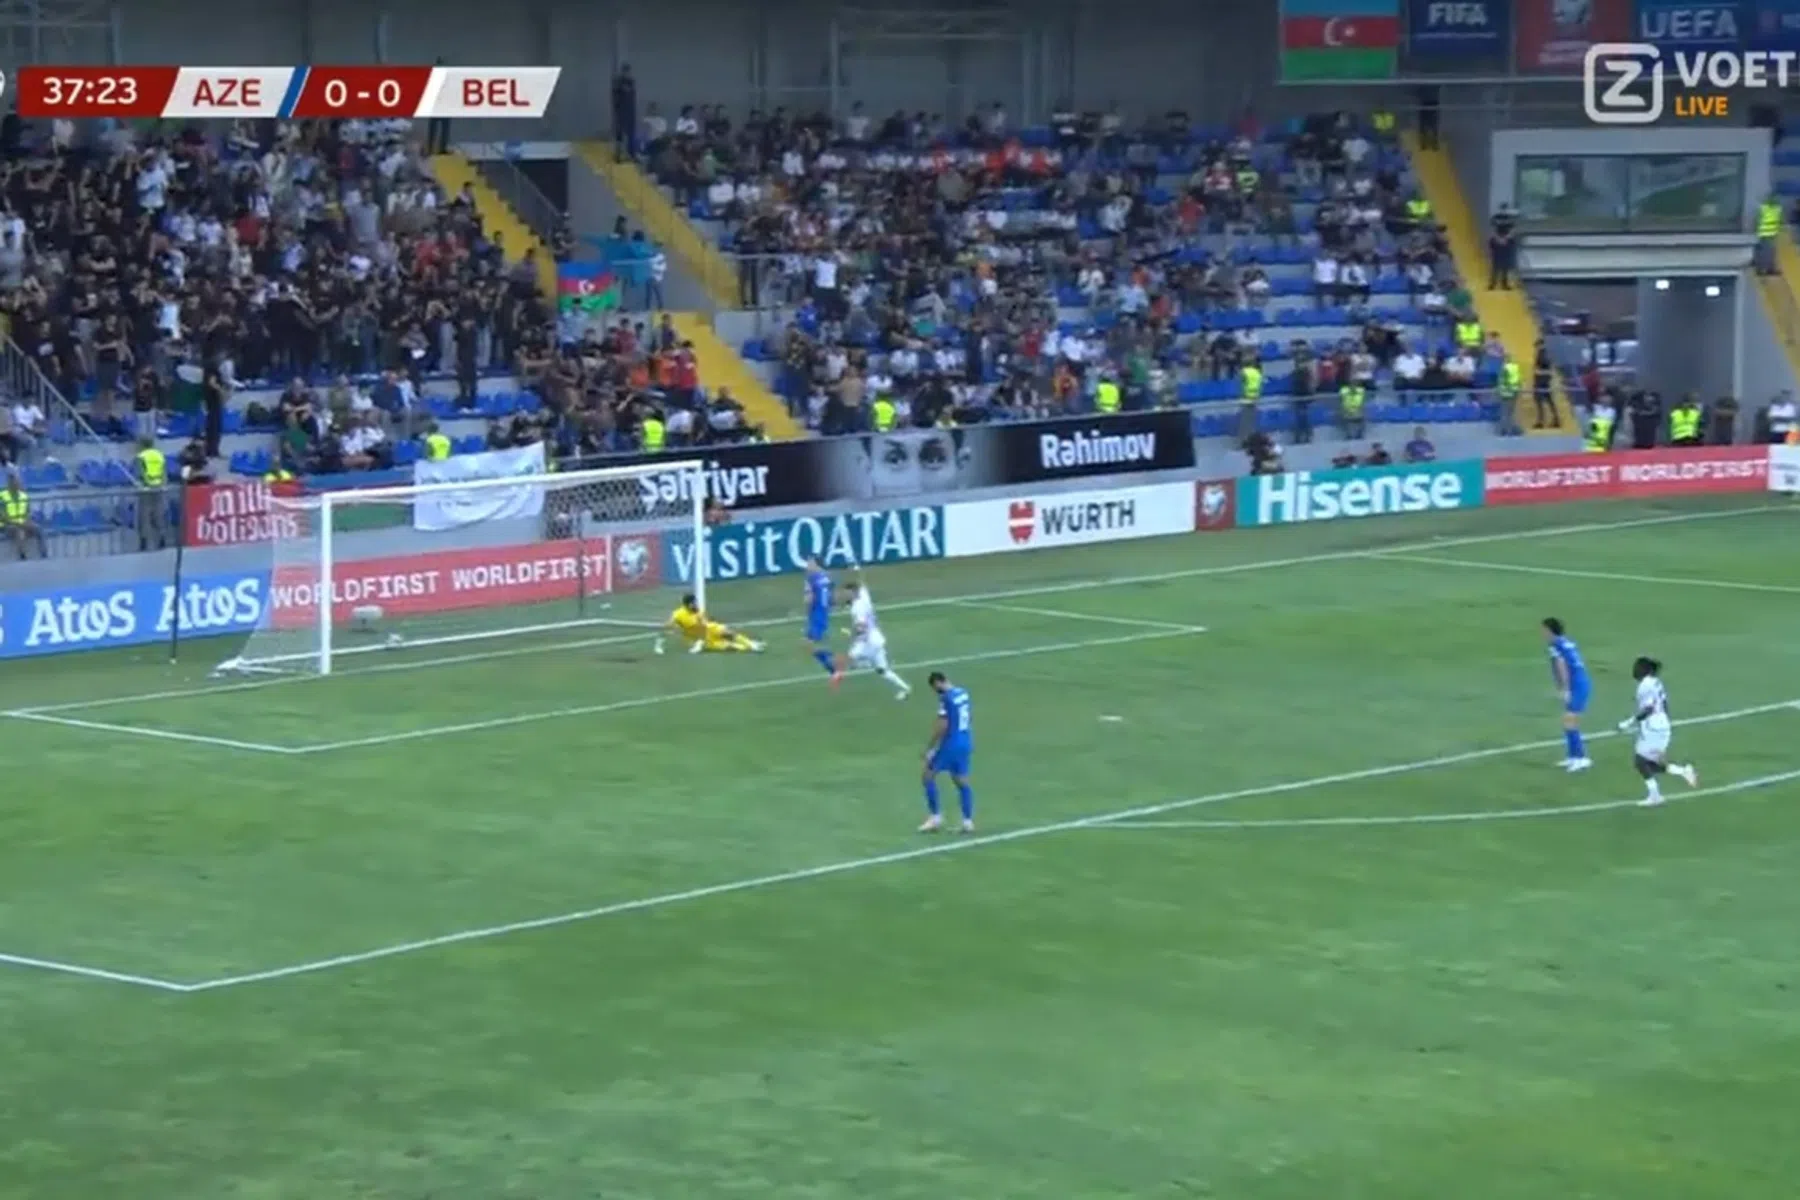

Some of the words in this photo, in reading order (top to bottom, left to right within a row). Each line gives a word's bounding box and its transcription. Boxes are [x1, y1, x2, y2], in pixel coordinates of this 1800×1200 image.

[1428, 3, 1487, 26] FIFA
[1642, 11, 1738, 38] UEFA
[1486, 465, 1612, 490] WORLDFIRST
[1619, 459, 1767, 482] WORLDFIRST
[1258, 471, 1461, 523] Hisense
[1043, 500, 1136, 534] WÜRTH
[671, 522, 783, 582] visit
[788, 506, 940, 569] QATAR
[452, 554, 605, 589] WORLDFIRST
